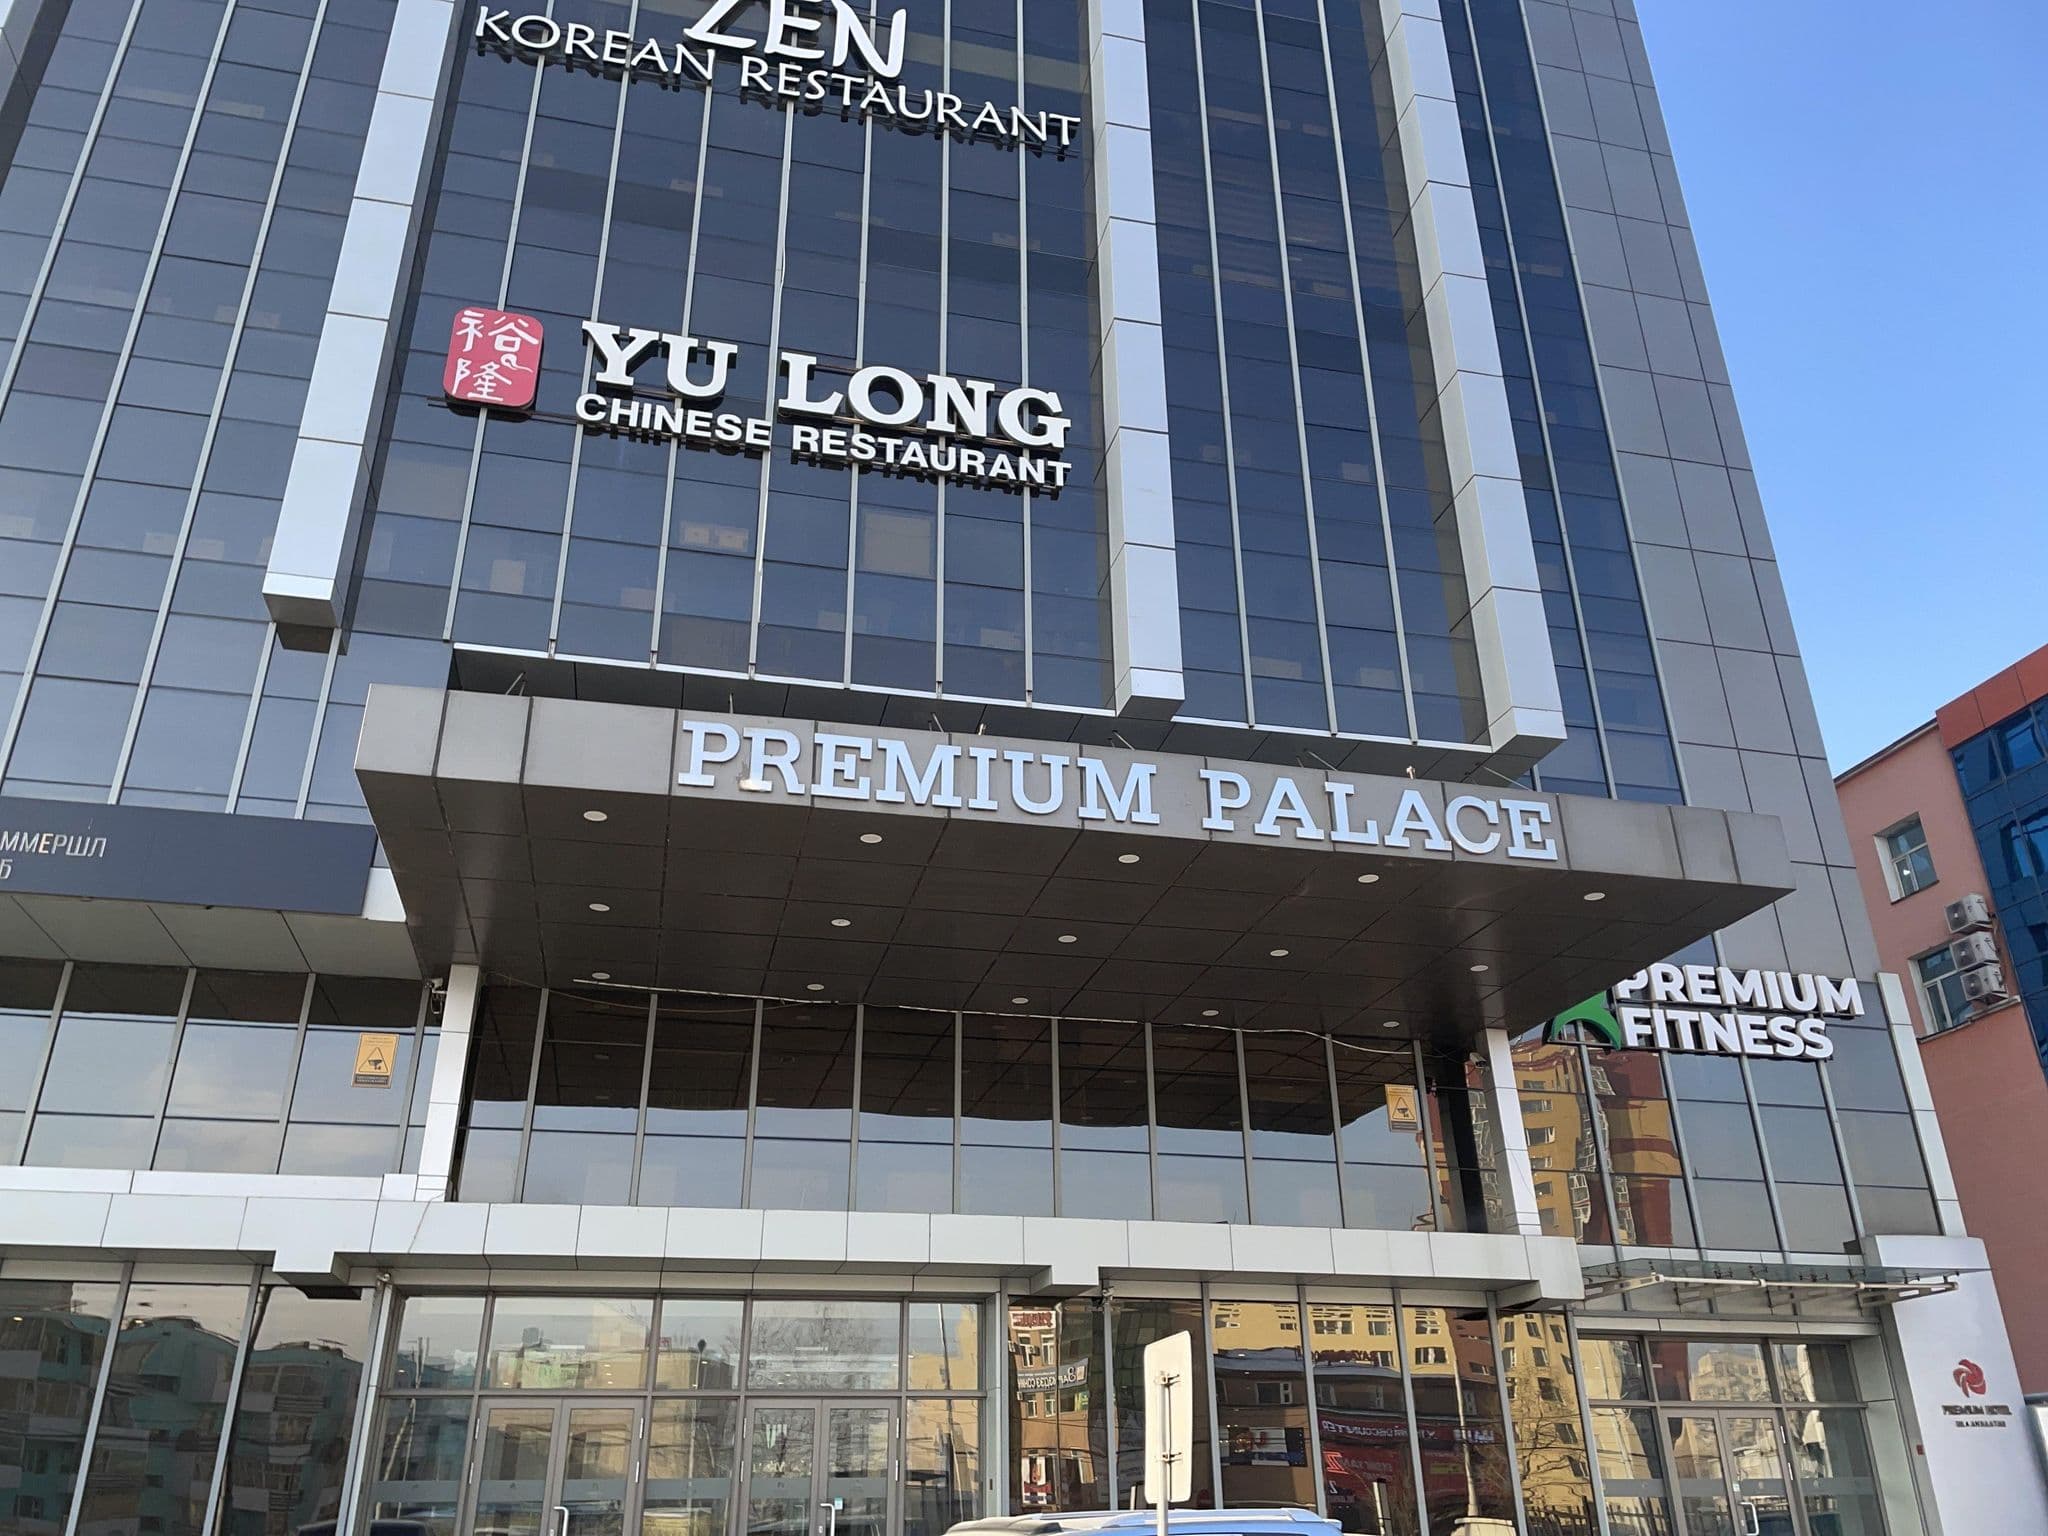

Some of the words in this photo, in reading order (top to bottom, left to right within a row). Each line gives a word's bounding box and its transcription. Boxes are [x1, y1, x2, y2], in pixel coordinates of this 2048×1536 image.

[476, 7, 716, 81] KOREAN
[740, 55, 1081, 146] RESTAURANT
[683, 0, 907, 78] ZEN
[582, 320, 738, 399] YU
[777, 351, 1072, 449] LONG
[575, 393, 772, 448] CHINESE
[791, 425, 1072, 487] RESTAURANT
[677, 720, 1161, 826] PREMIUM
[1201, 768, 1559, 862] PALACE
[0, 830, 107, 858] ММЕРШЛ
[1615, 962, 1866, 1017] PREMIUM
[1619, 1007, 1834, 1059] FITNESS
